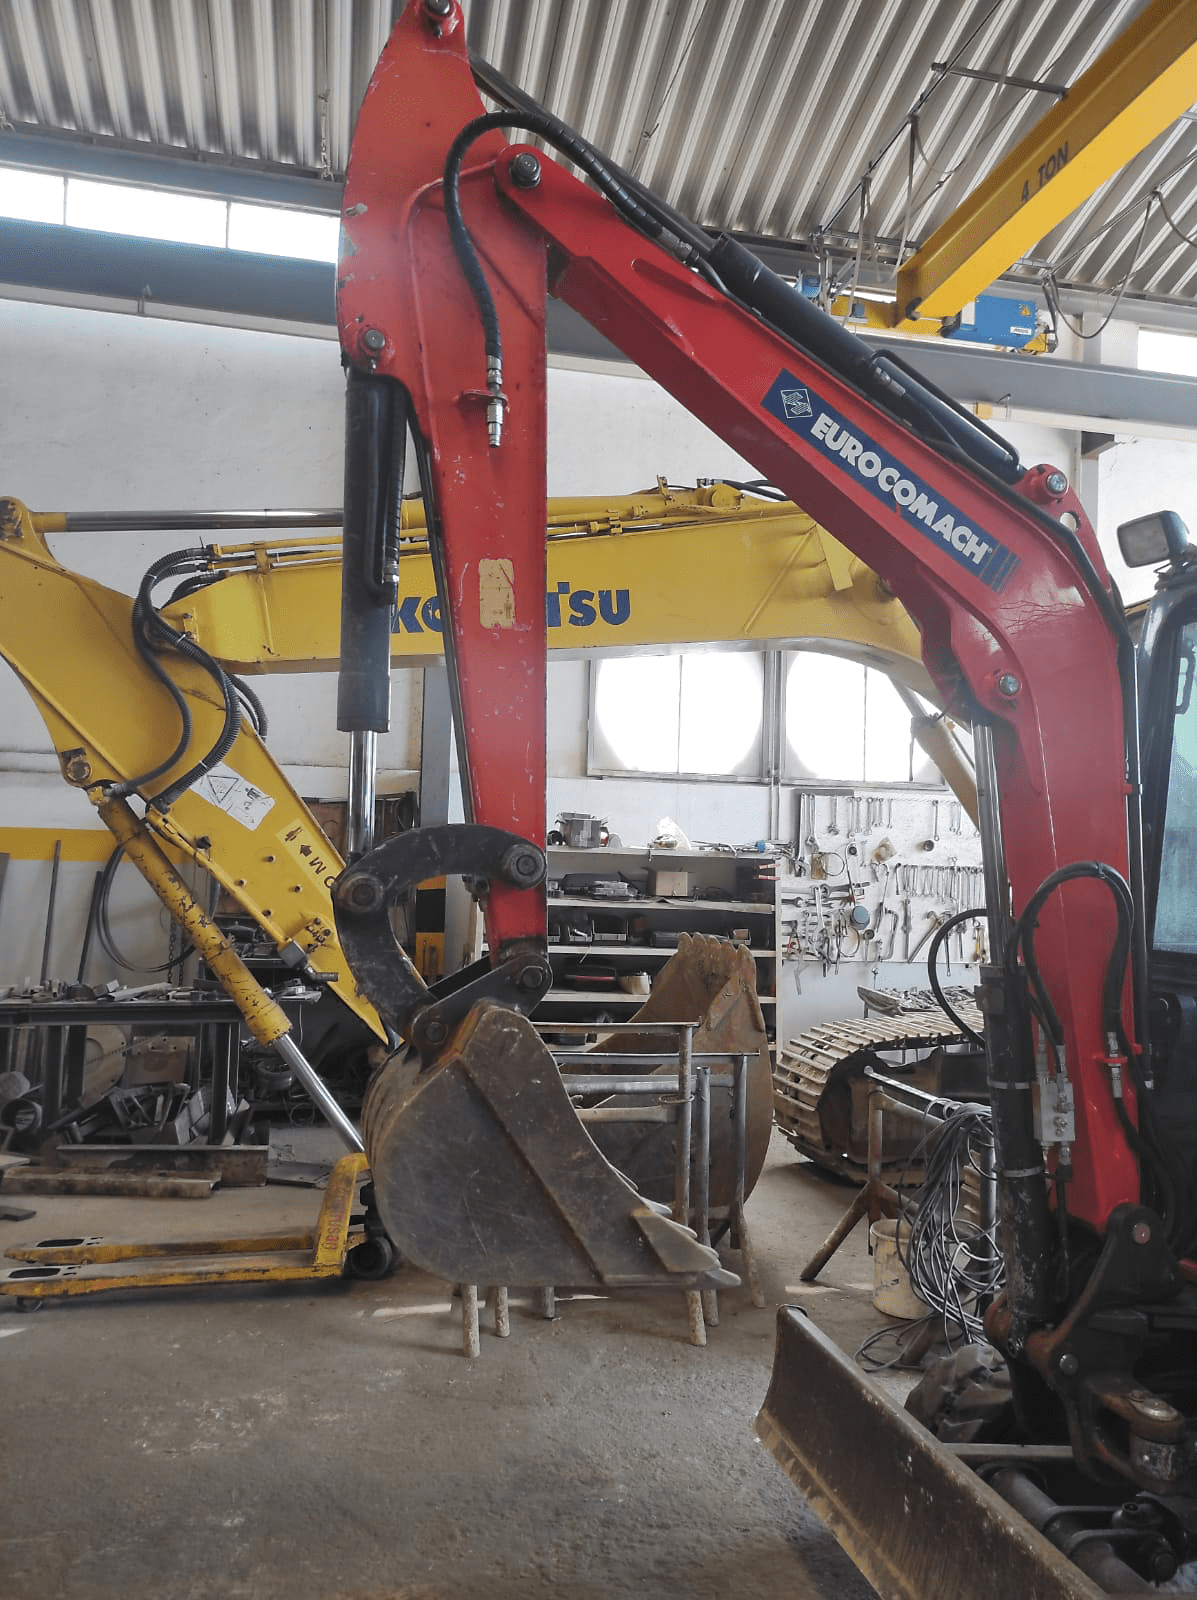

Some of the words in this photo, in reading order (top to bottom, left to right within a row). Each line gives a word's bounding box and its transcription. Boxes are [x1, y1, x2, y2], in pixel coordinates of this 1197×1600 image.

[1020, 180, 1031, 202] 4
[1038, 141, 1069, 189] TON
[810, 412, 993, 565] EUROCOMACH
[391, 581, 631, 634] KOTSU
